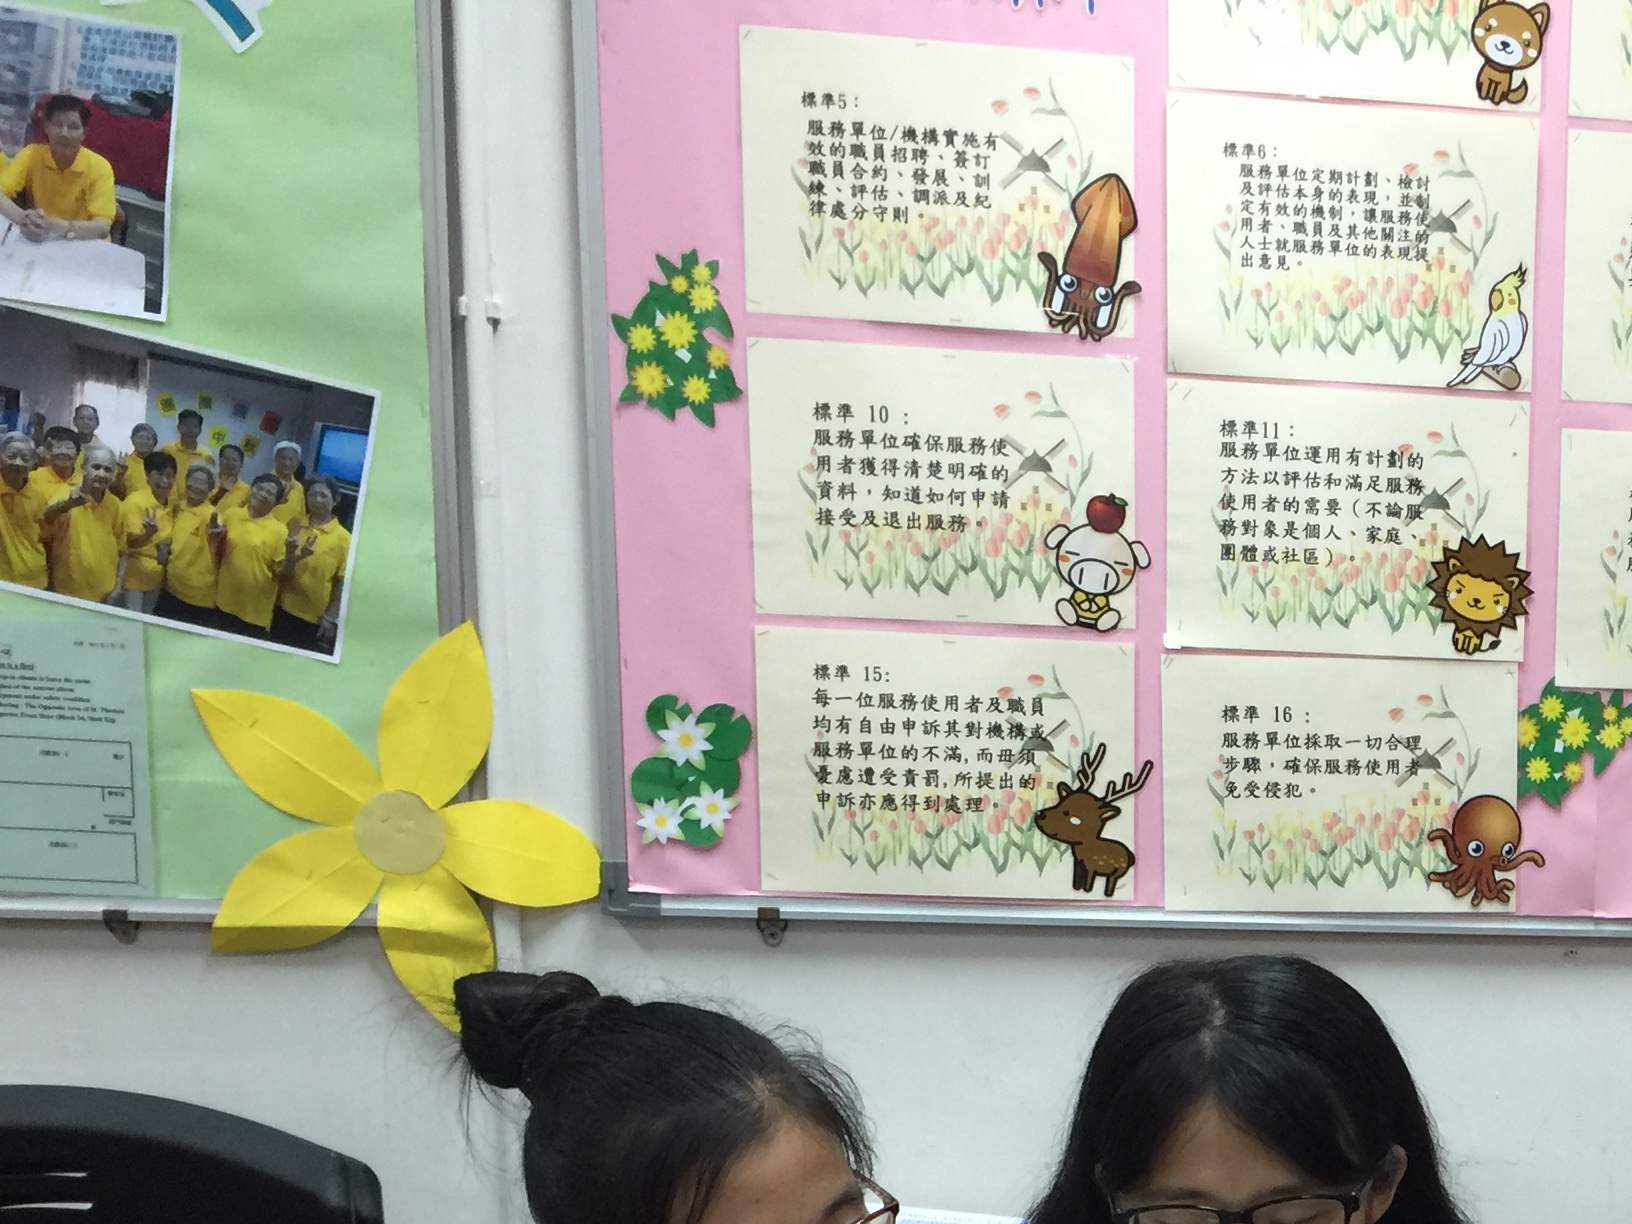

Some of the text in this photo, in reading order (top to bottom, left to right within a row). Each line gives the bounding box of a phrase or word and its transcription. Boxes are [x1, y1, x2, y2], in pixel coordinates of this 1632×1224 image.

[812, 402, 855, 424] 標準
[812, 663, 851, 683] 標準
[1222, 704, 1260, 724] 標準
